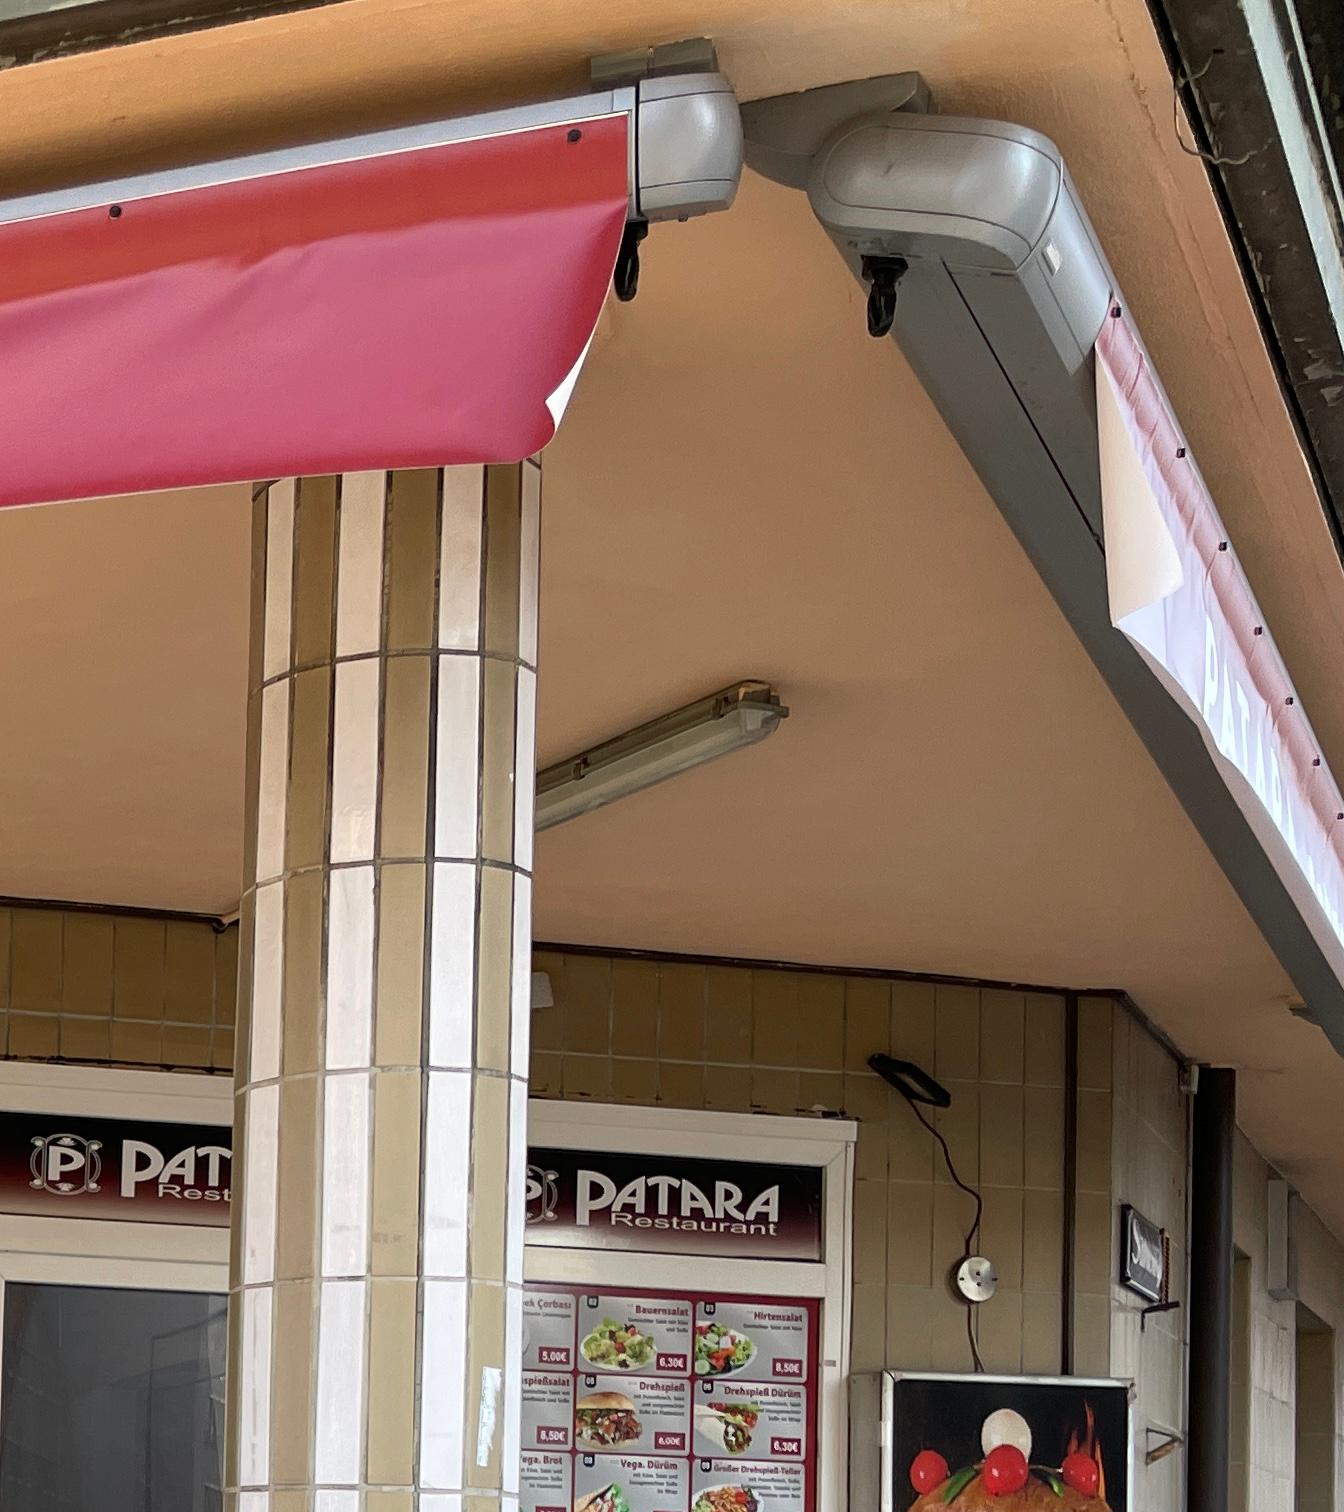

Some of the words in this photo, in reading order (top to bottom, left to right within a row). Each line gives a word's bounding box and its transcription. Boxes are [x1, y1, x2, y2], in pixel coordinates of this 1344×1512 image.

[575, 1168, 780, 1226] PATARA
[611, 1210, 778, 1237] Restaurant
[635, 1305, 689, 1317] Bauernsalat
[754, 1311, 803, 1323] Hirtensalat
[639, 1380, 686, 1393] Drehspieß
[724, 1386, 769, 1399] Drehspieß
[771, 1387, 802, 1398] Dürüm
[543, 1455, 563, 1465] Brot
[621, 1459, 644, 1472] Vega.
[647, 1458, 679, 1471] Dürüm
